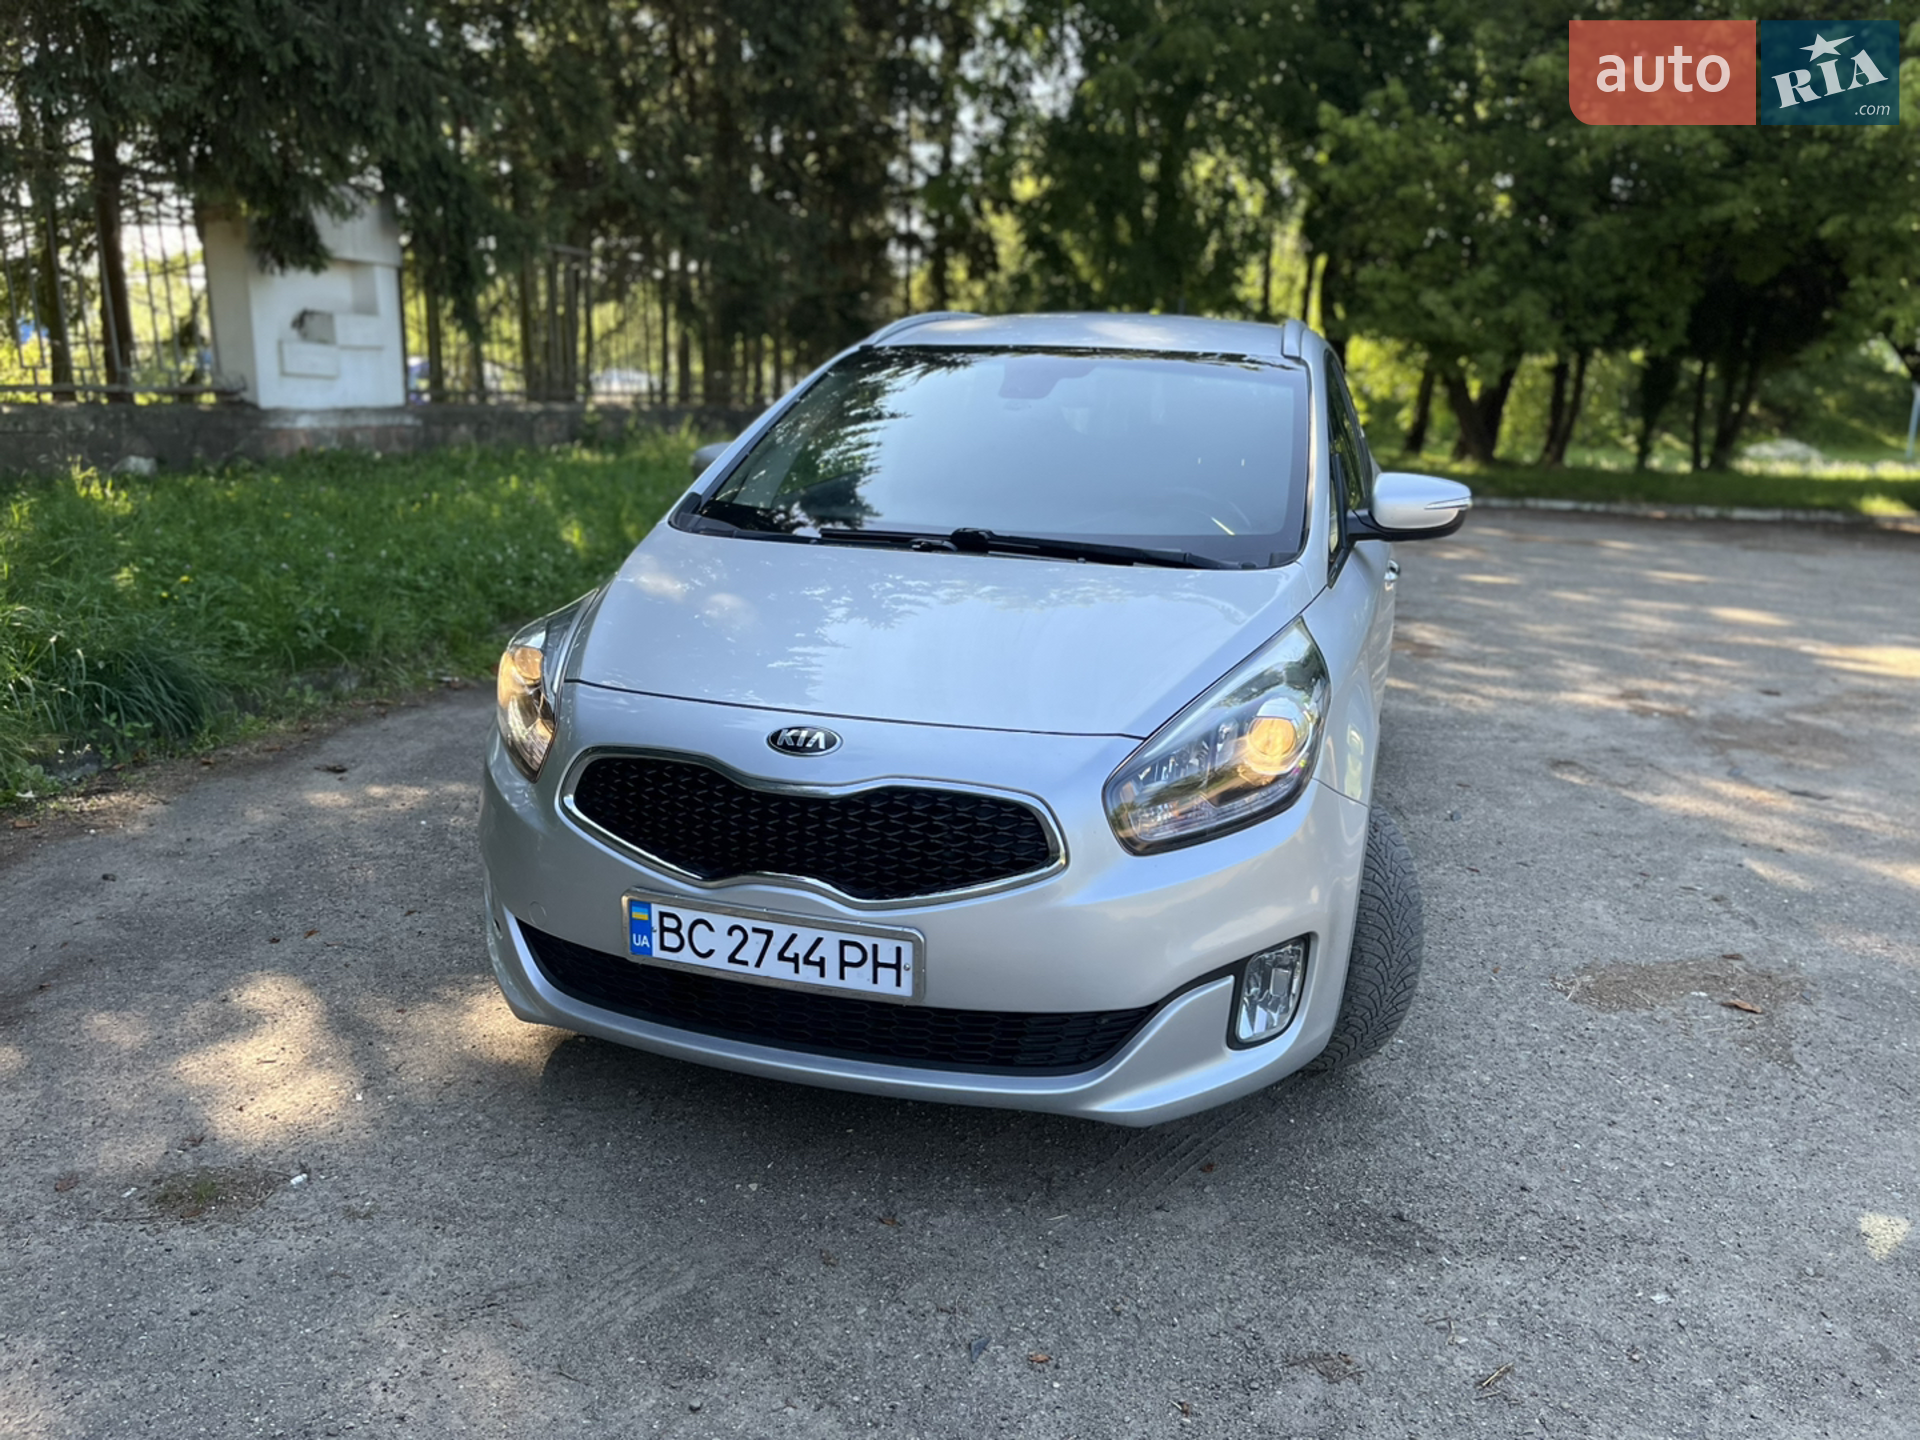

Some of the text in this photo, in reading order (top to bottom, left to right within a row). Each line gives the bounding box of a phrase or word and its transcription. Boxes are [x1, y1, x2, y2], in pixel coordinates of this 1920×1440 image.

[776, 728, 826, 749] KIA
[632, 933, 650, 948] UA
[658, 911, 903, 988] BC 2744 PH
